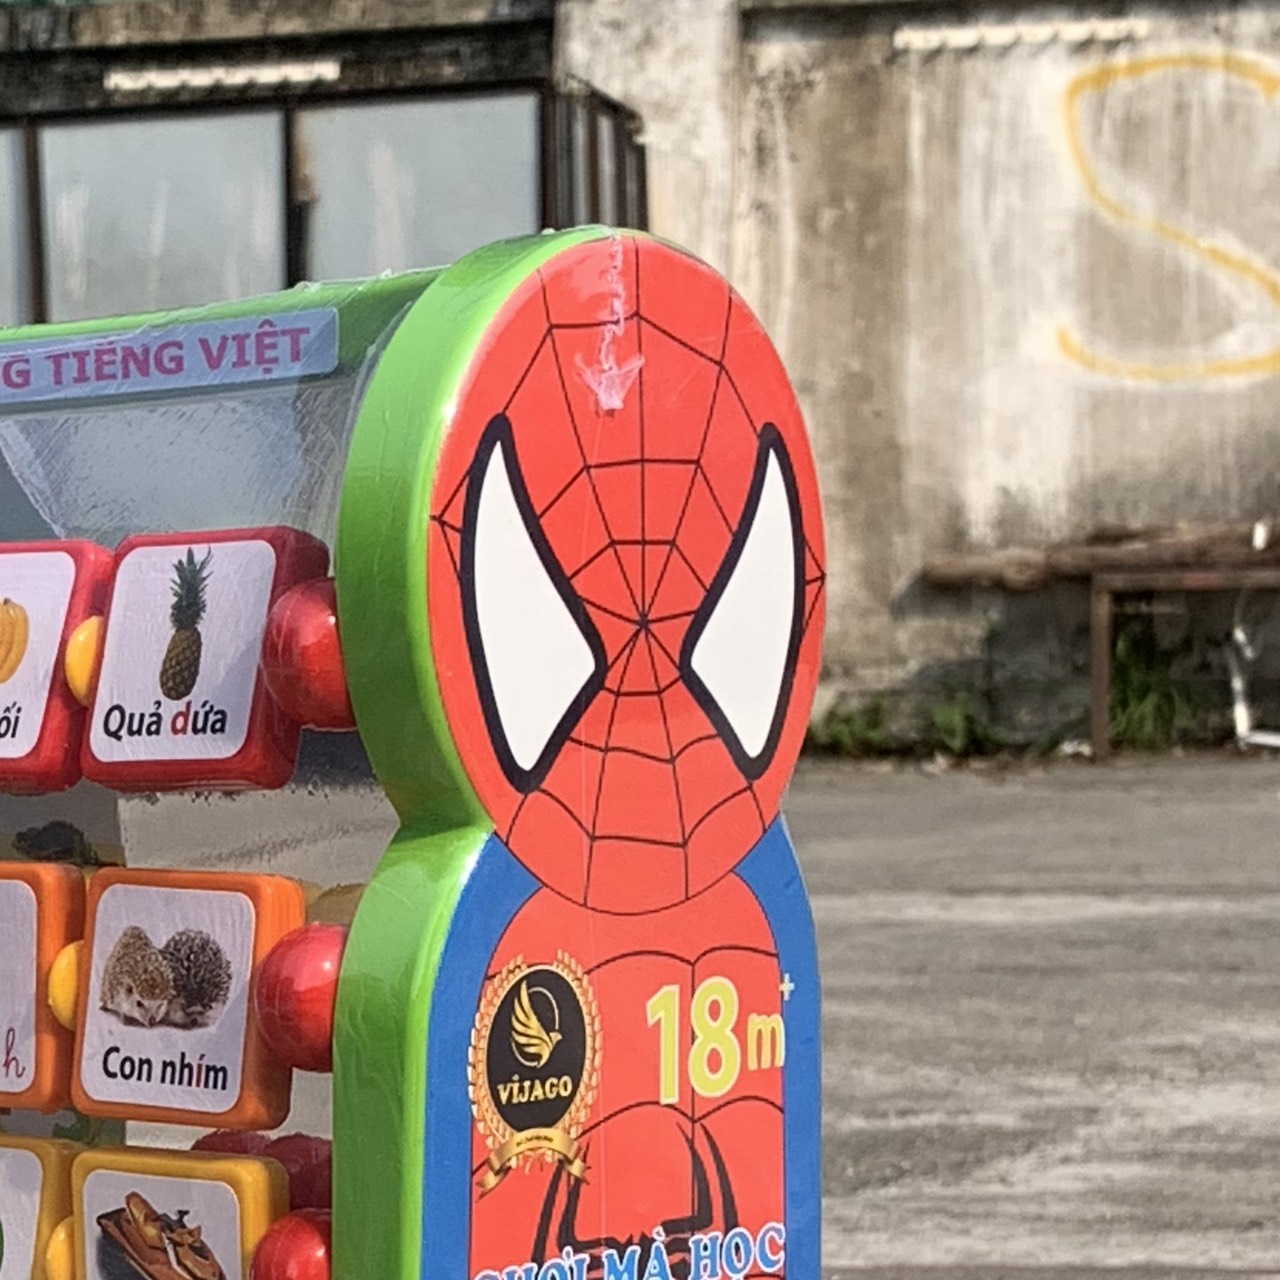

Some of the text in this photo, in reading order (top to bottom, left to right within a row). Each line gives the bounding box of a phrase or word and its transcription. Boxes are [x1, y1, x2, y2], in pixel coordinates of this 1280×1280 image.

[199, 319, 311, 374] VIỆT
[102, 700, 228, 741] Quả dứa
[102, 1045, 229, 1091] Con nhím
